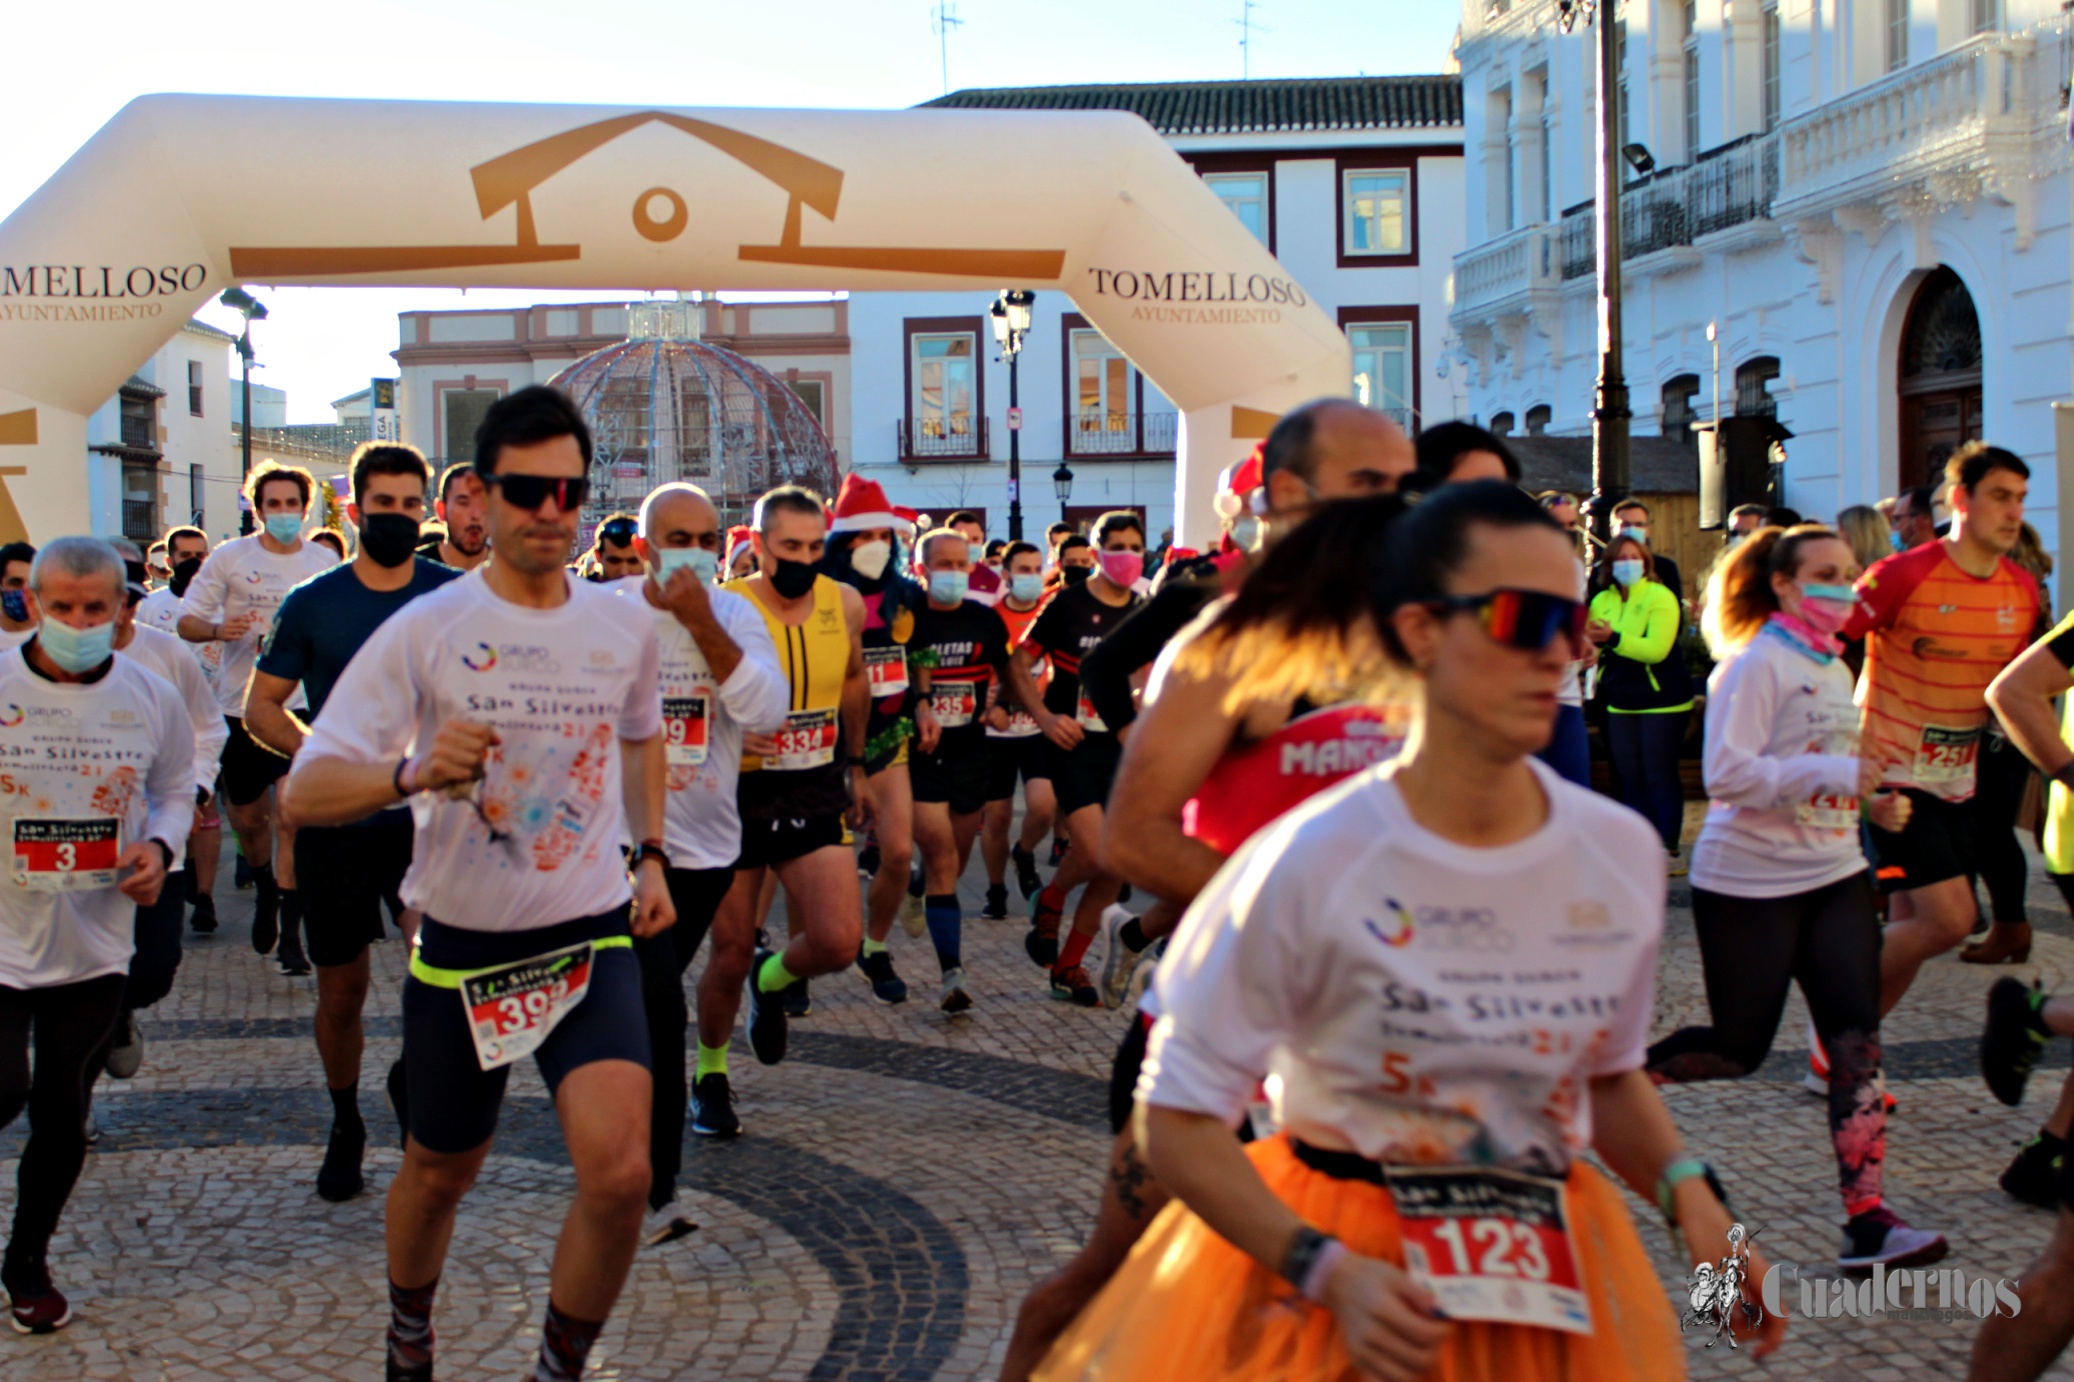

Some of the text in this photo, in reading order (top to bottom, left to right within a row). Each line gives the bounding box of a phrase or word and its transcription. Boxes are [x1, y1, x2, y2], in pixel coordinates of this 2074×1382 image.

[3, 264, 207, 298] MELLOSO
[1088, 268, 1307, 307] TOMELLOSO
[1131, 306, 1281, 324] AYUNTAMIENTO
[467, 694, 514, 711] San
[46, 746, 143, 760] Silvestre
[779, 728, 823, 755] 334
[54, 842, 77, 871] 3
[1432, 1217, 1549, 1281] 123
